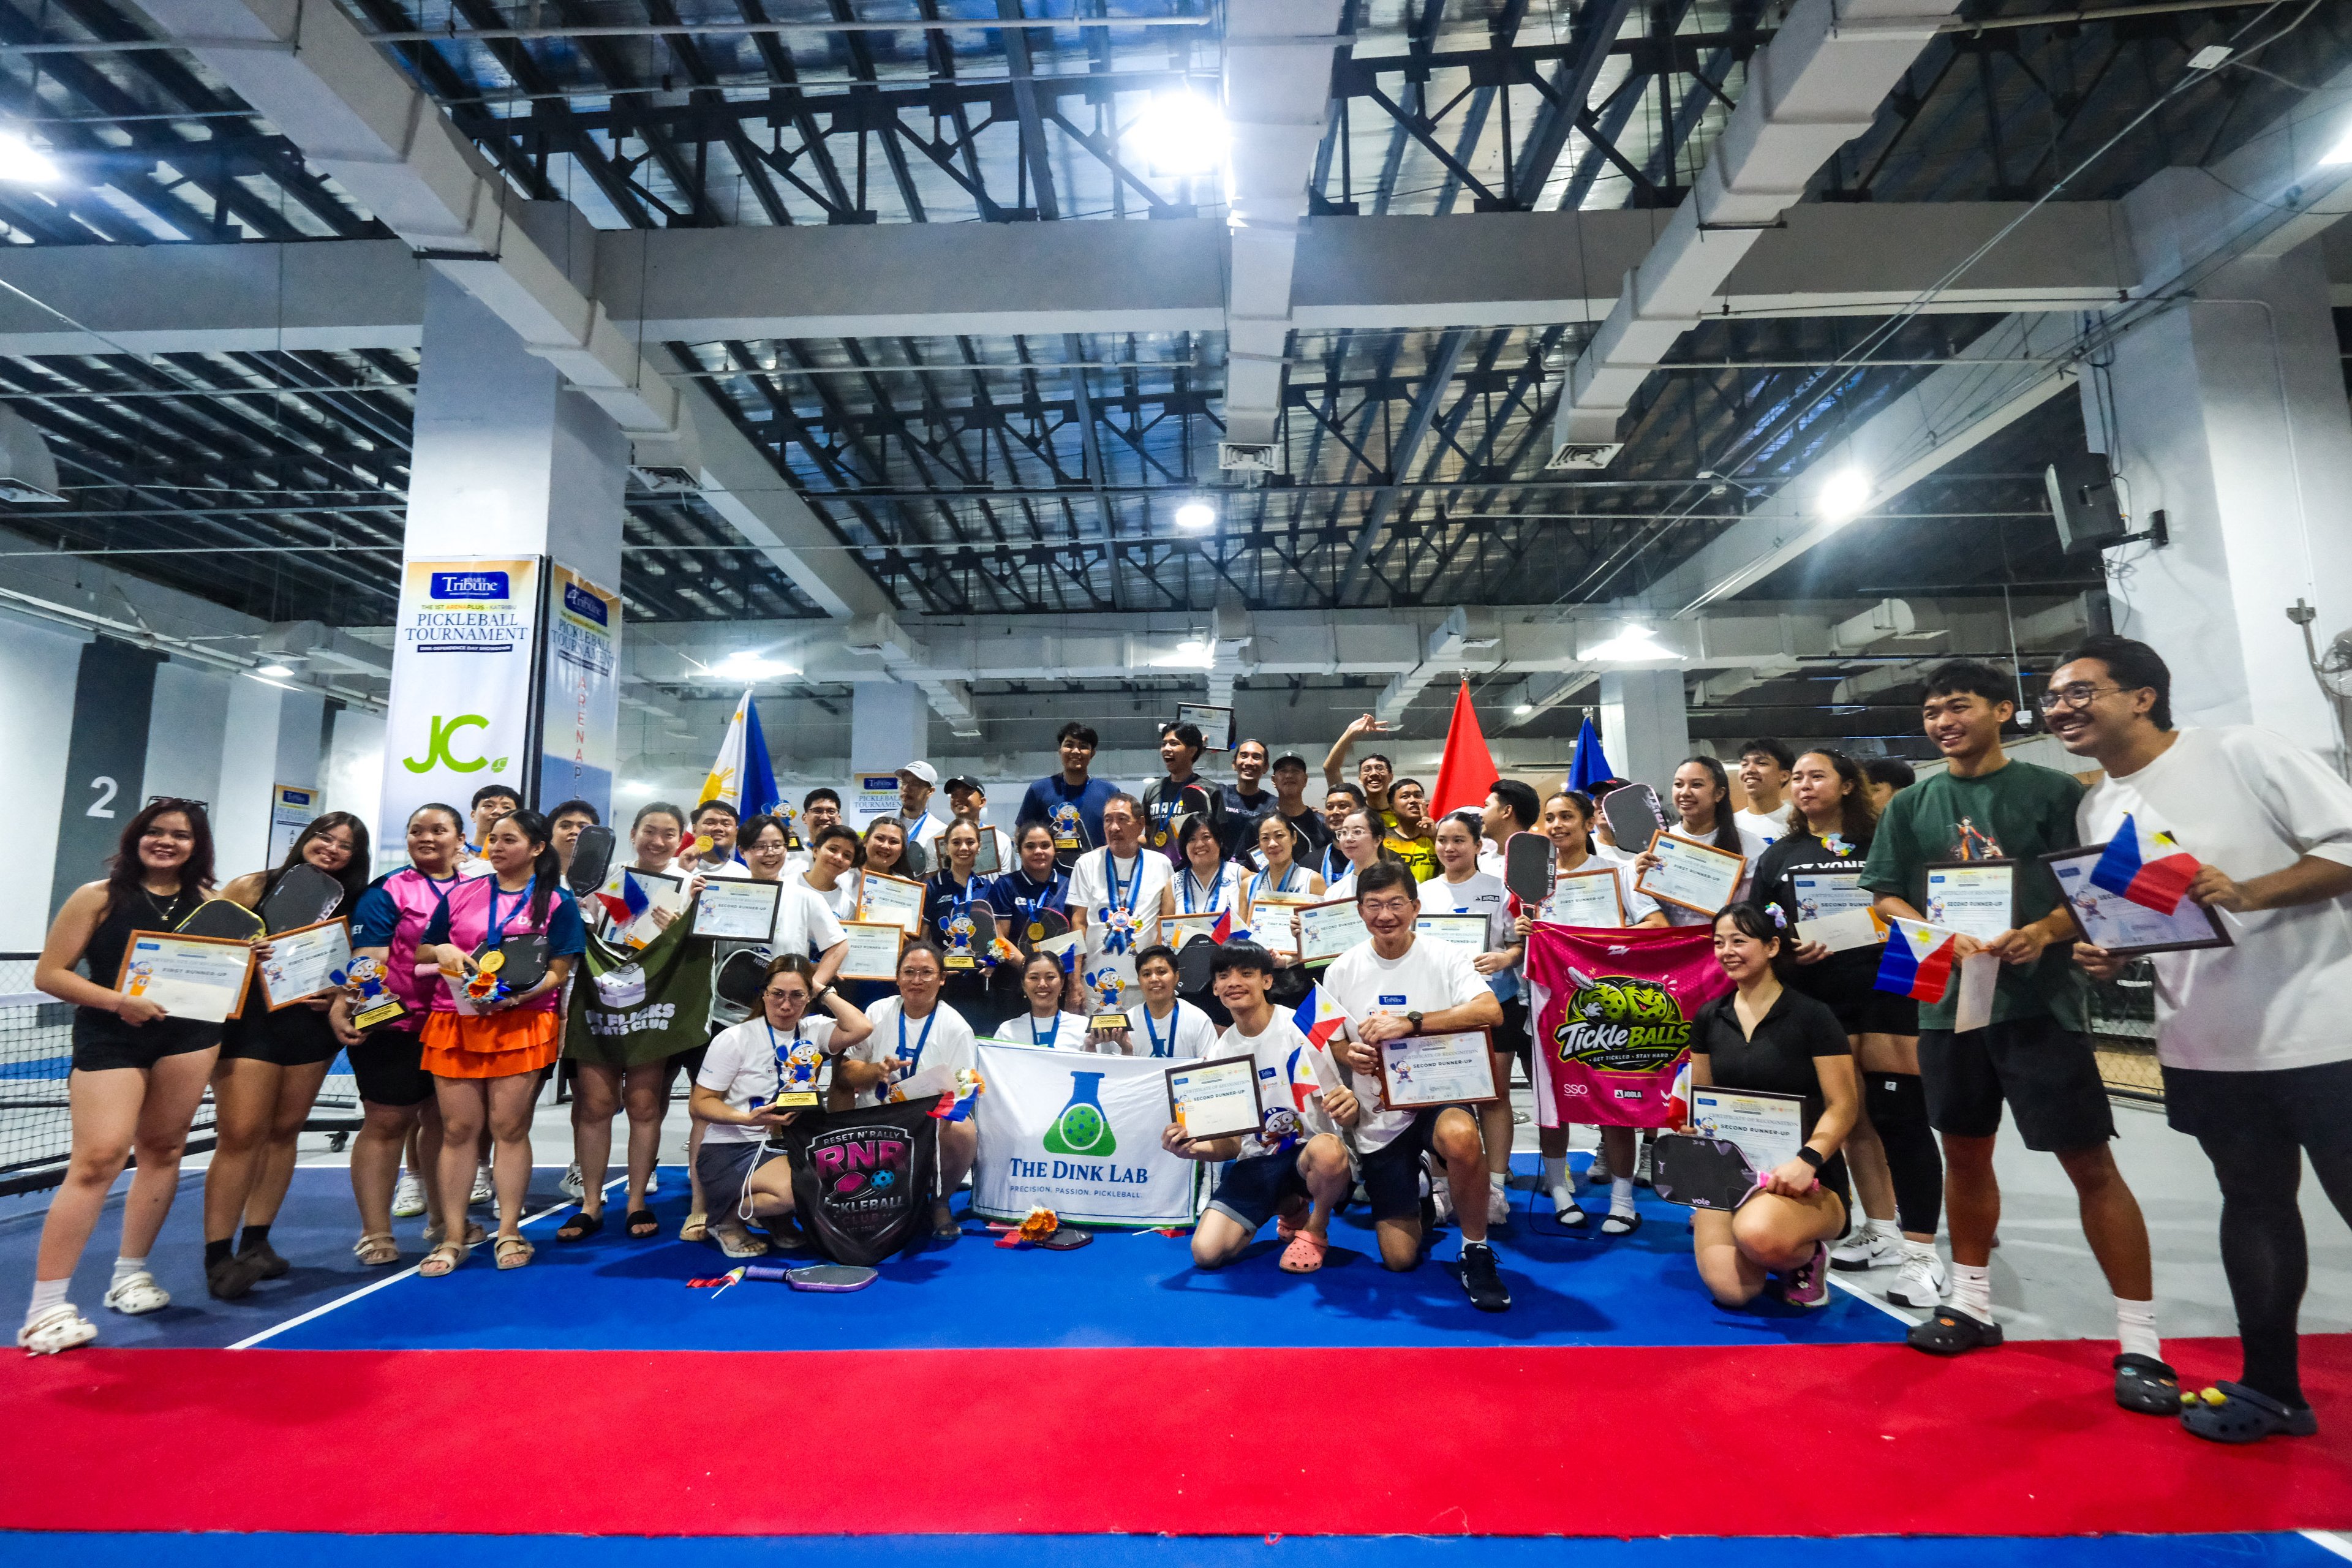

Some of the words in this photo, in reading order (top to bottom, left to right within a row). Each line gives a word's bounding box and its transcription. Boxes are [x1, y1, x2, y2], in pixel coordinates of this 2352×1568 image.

[442, 577, 498, 592] Tribune
[417, 613, 518, 626] PICKLEBALL
[405, 627, 528, 641] TOURNAMENT
[402, 714, 489, 774] JC
[86, 776, 119, 819] 2
[185, 968, 227, 977] RUNNER-UP
[631, 1019, 669, 1031] CLUB
[1563, 1084, 1588, 1095] SSO
[823, 1133, 854, 1145] RESET
[813, 1140, 908, 1180] RNR
[842, 1213, 880, 1223] CLUB
